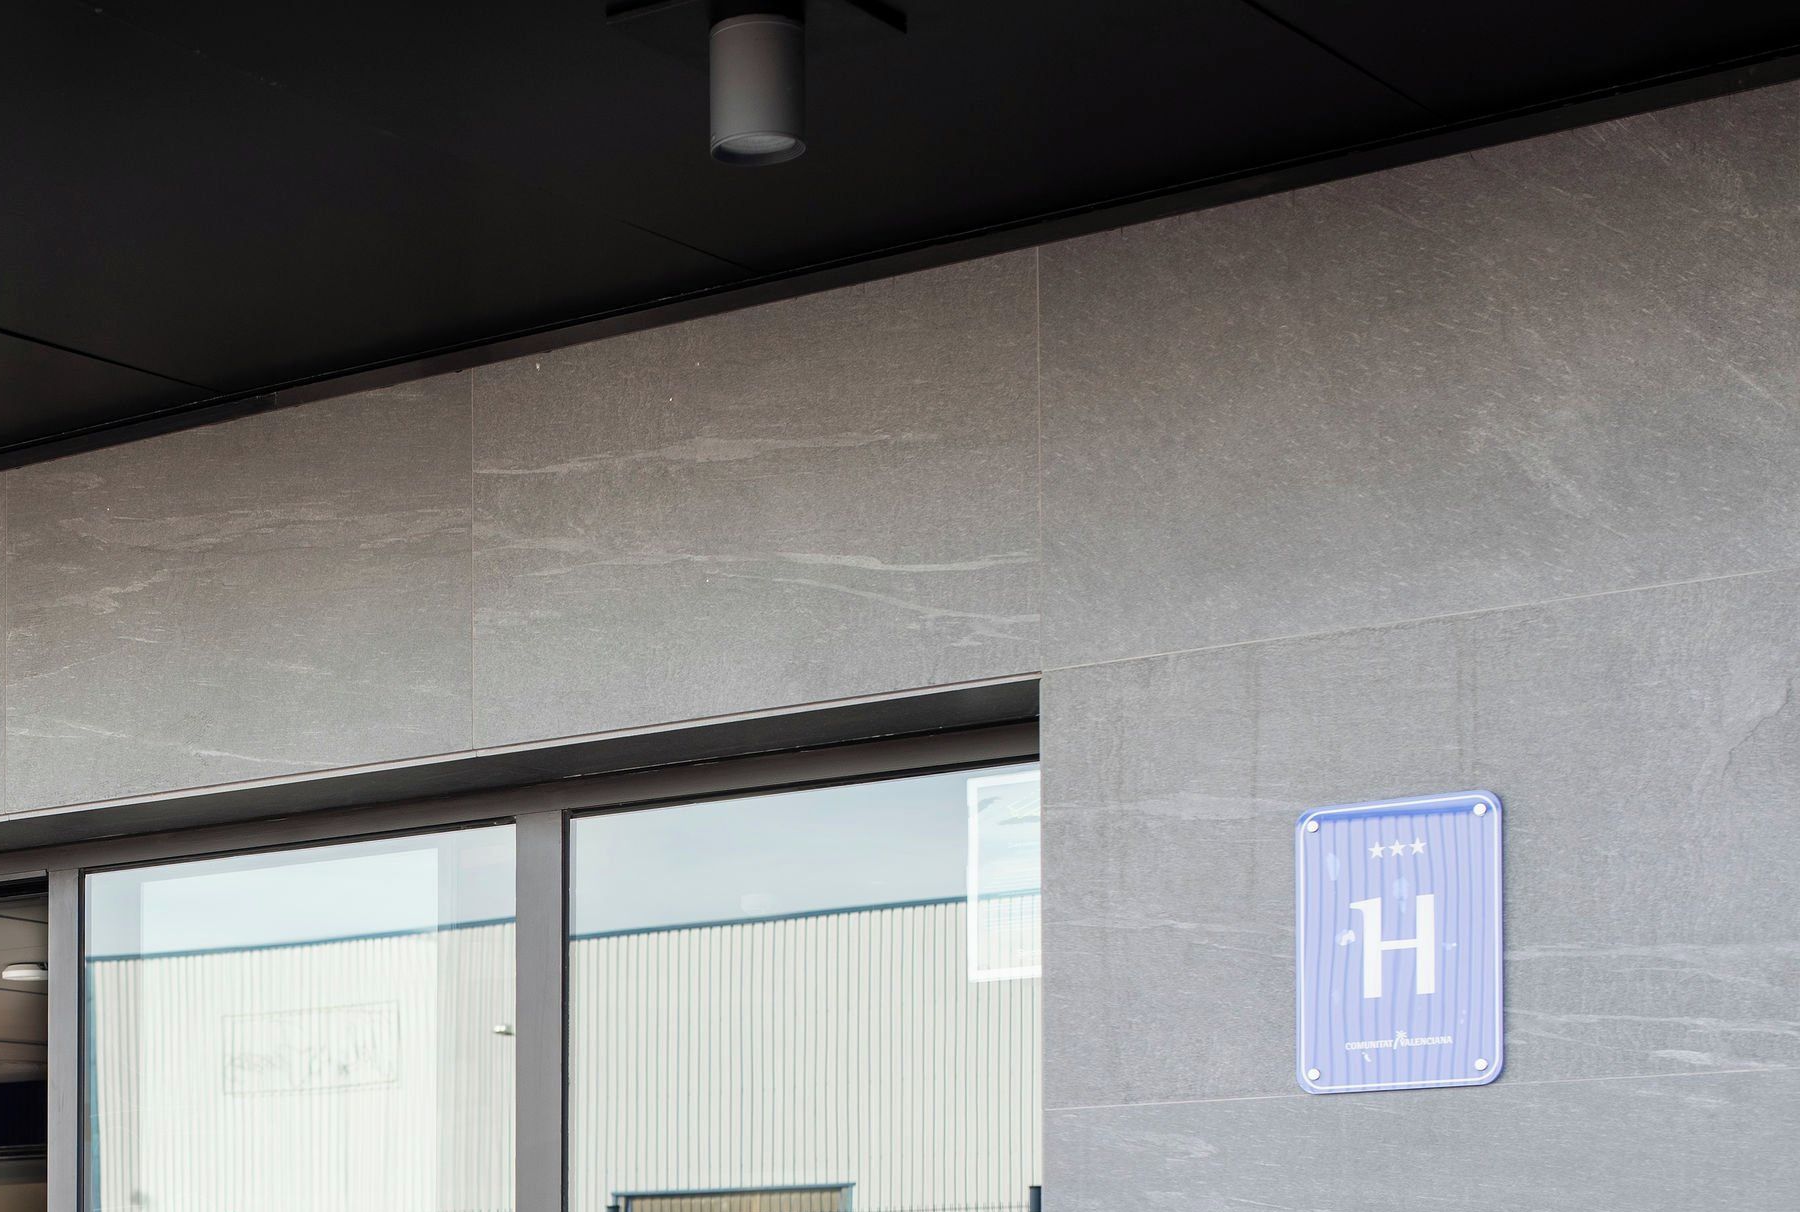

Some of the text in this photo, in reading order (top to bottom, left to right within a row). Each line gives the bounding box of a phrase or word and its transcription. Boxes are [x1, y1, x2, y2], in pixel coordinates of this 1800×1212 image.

[1350, 894, 1435, 999] H
[1345, 1035, 1454, 1051] COMUNITAT VALENCIANA
